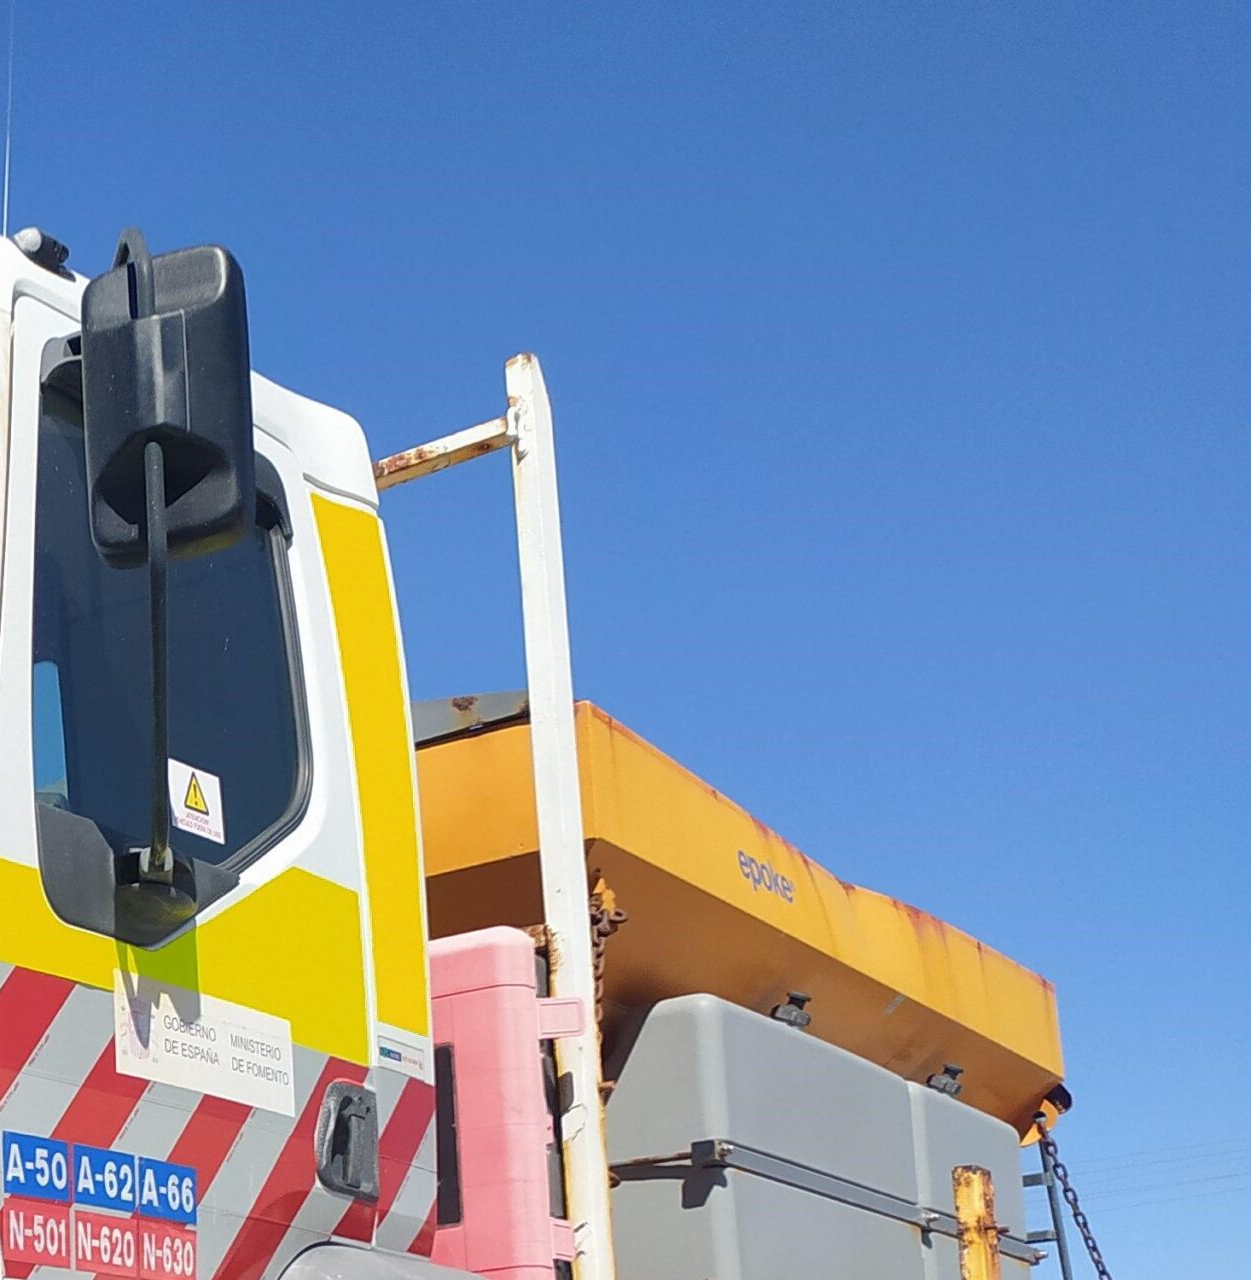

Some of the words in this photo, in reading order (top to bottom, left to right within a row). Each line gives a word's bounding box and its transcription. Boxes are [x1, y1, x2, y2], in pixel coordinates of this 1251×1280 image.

[737, 850, 794, 904] epoke
[163, 1014, 217, 1042] GOBIERNO
[230, 1033, 282, 1061] MINISTERIO
[163, 1038, 179, 1056] DE
[180, 1042, 220, 1065] ESPAÑA
[231, 1057, 245, 1073] DE
[246, 1061, 290, 1086] FOMENTO
[5, 1143, 67, 1190] A-50
[76, 1155, 133, 1202] A-62
[141, 1168, 195, 1214] A-66
[8, 1209, 66, 1257] N-501
[77, 1220, 135, 1268] N-620
[143, 1232, 194, 1277] N-630
